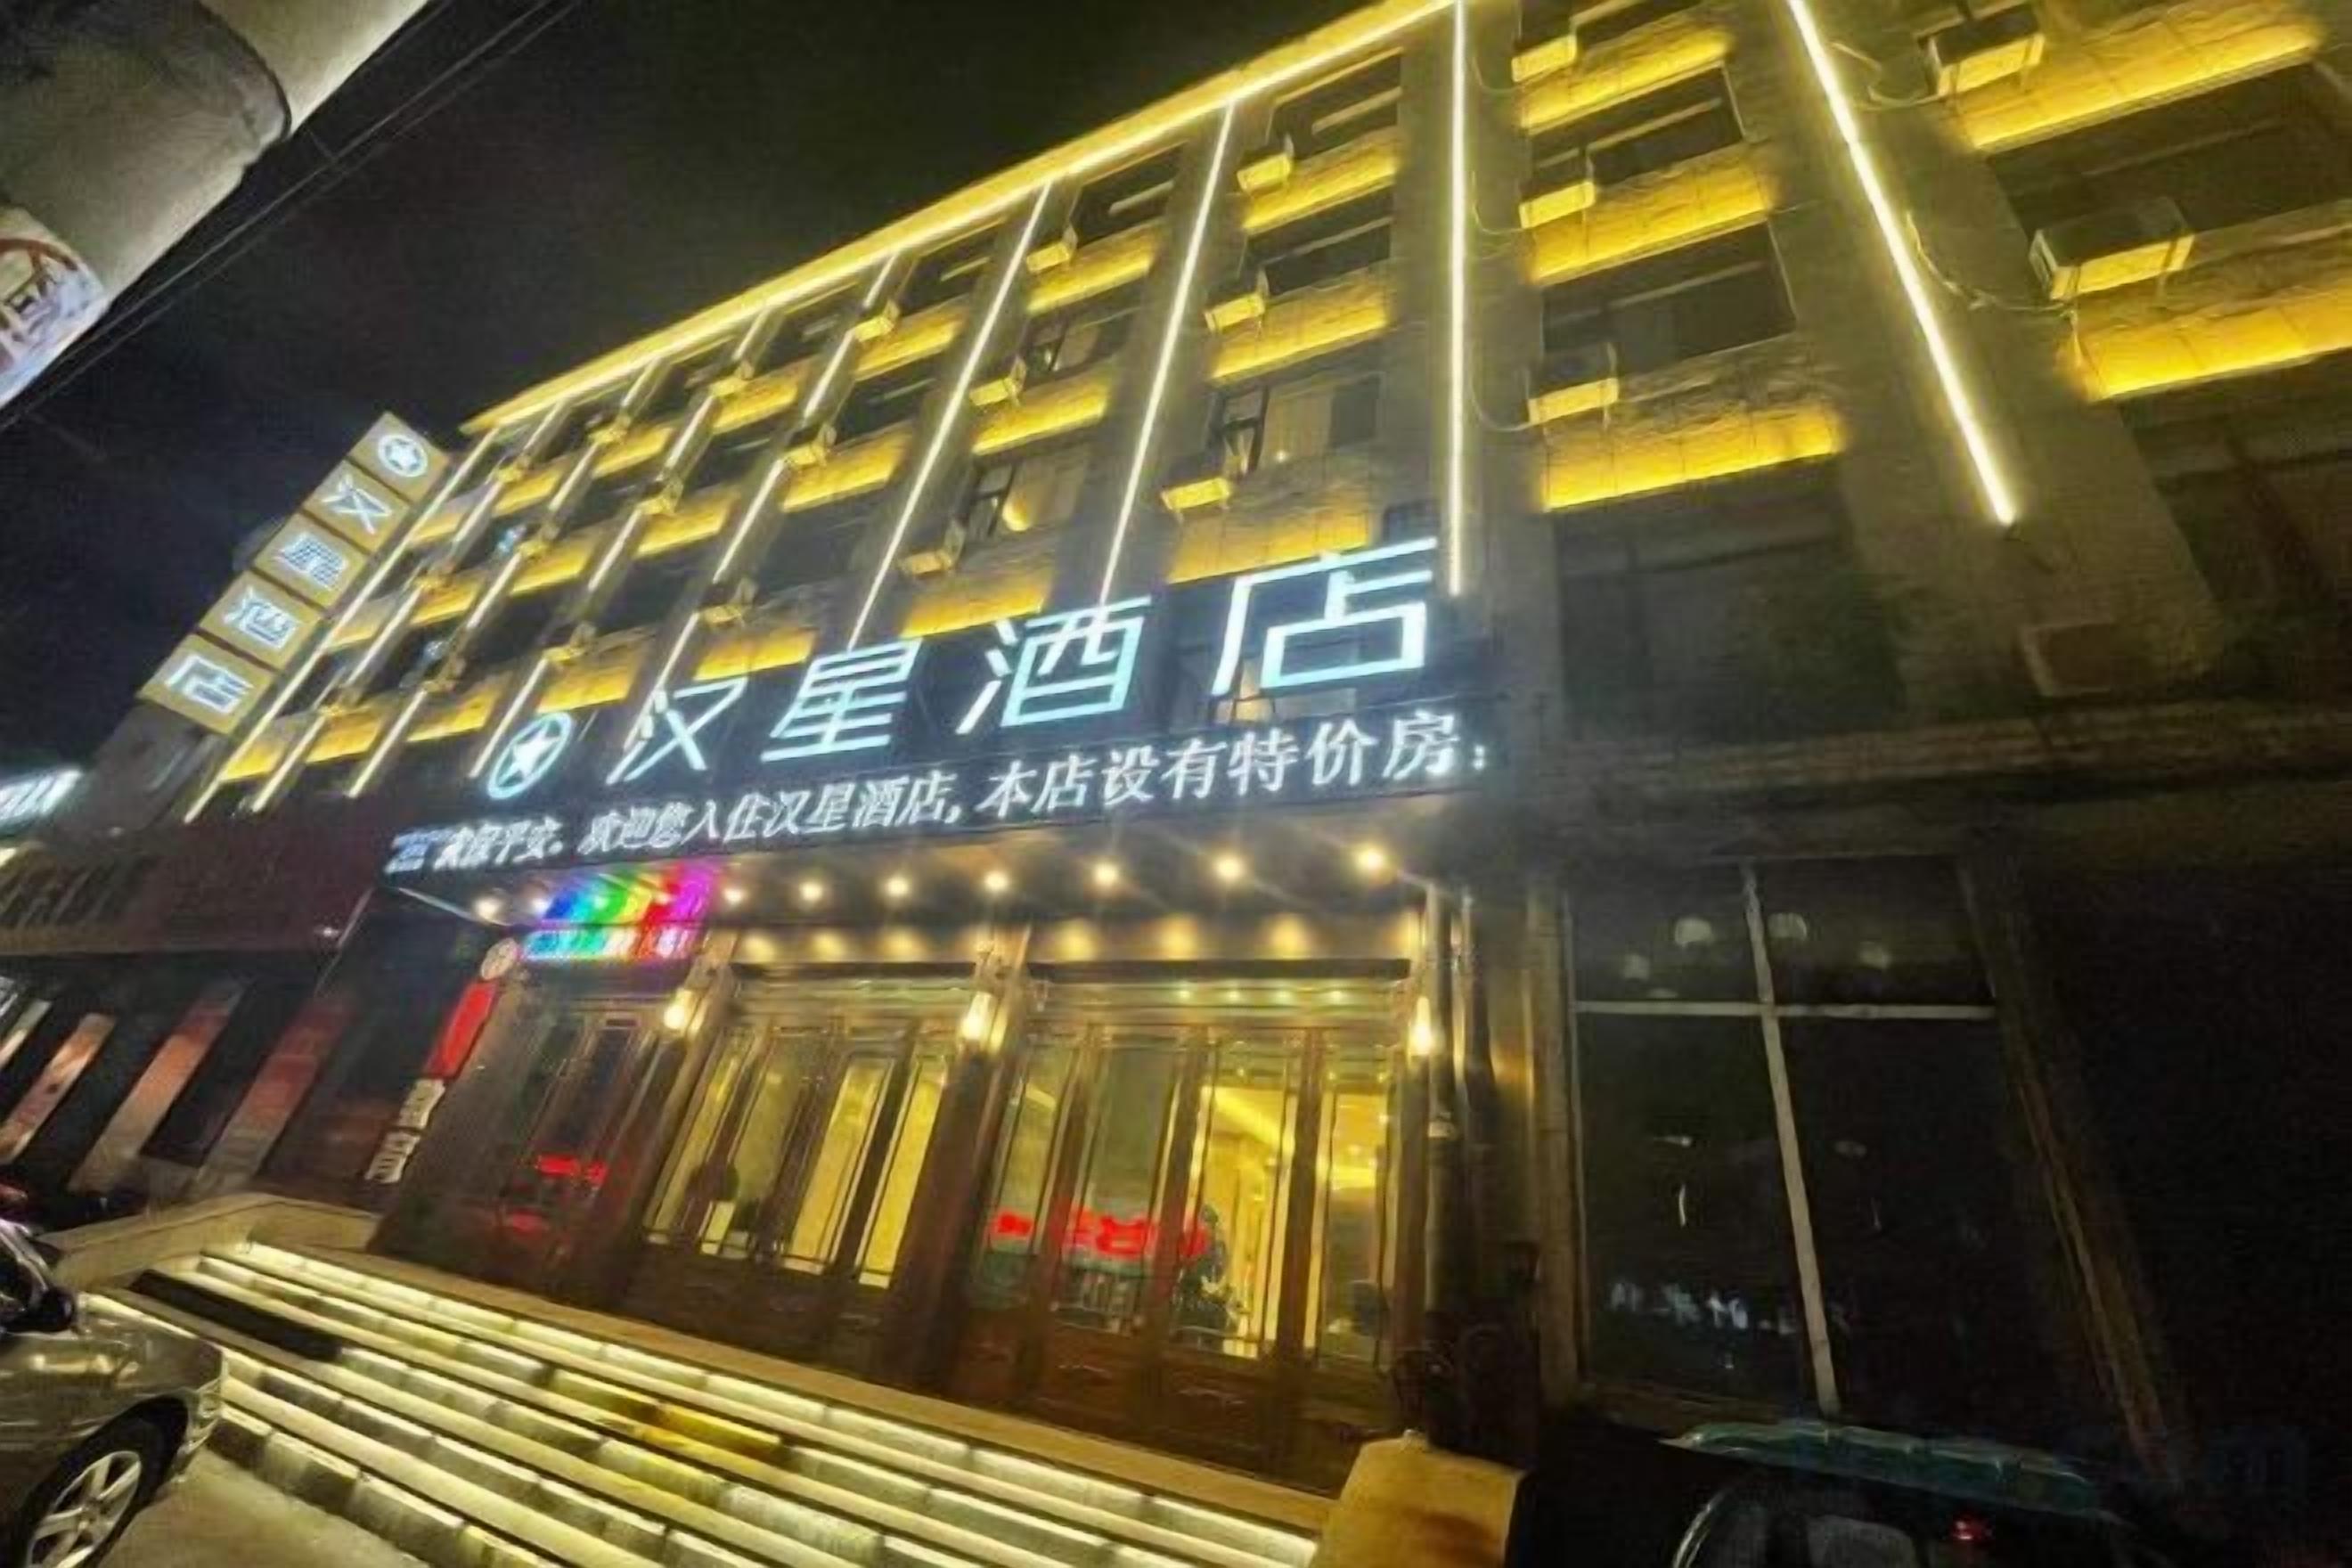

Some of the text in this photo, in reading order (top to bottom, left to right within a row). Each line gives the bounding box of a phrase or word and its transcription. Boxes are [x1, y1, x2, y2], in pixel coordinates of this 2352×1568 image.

[165, 473, 393, 714] 汉星酒店
[606, 536, 1437, 786] 汉星酒店
